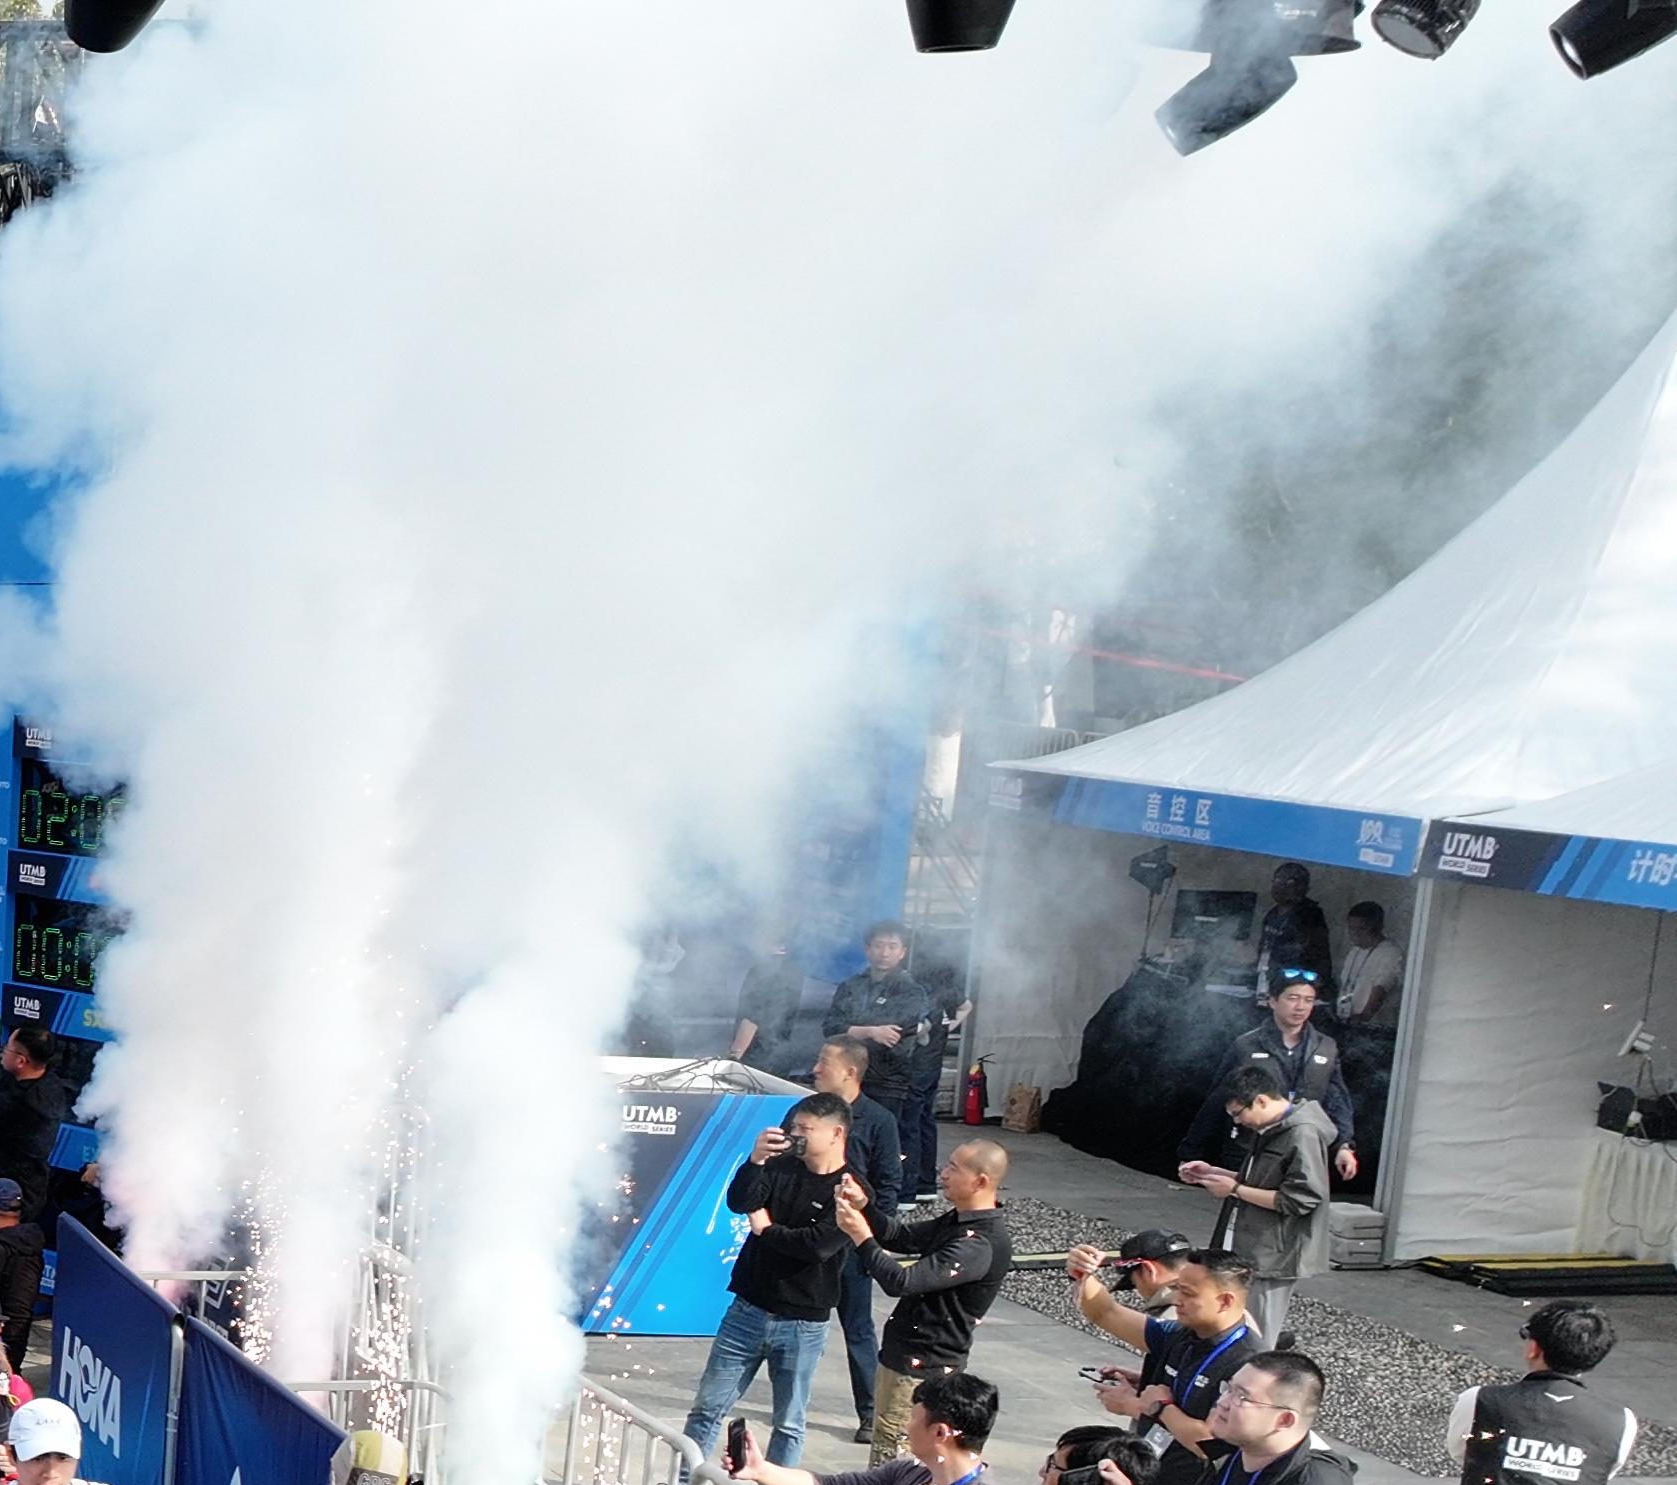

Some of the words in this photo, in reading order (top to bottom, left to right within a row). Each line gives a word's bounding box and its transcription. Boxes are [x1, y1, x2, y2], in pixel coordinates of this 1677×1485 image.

[1147, 792, 1212, 826] 音控区
[1442, 831, 1498, 861] UTMB
[19, 863, 46, 878] UTMB
[1628, 849, 1677, 886] 计时
[14, 996, 41, 1011] UTMB
[622, 1104, 681, 1123] UTMB
[60, 1324, 121, 1460] HOKA
[1506, 1437, 1587, 1468] UTMB
